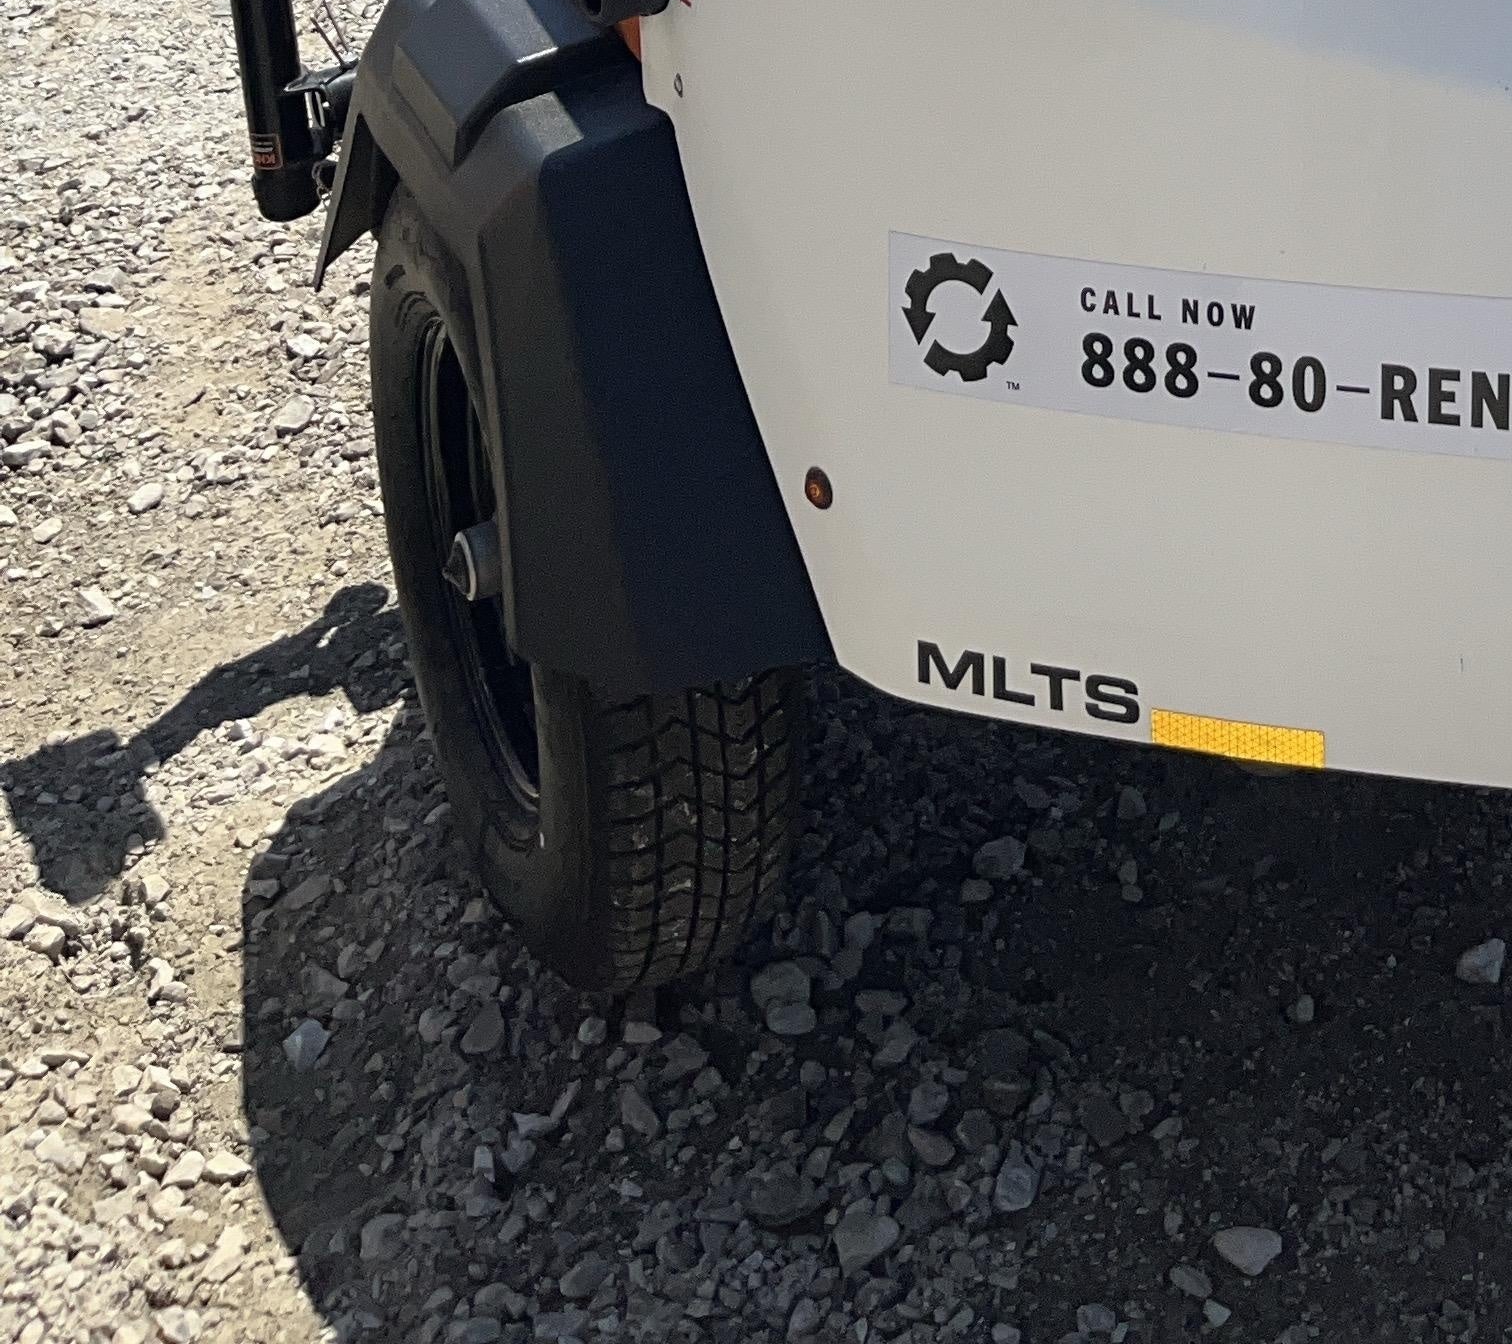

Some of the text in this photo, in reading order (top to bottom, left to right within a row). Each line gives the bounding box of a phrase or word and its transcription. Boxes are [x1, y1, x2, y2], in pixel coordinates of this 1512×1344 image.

[1079, 286, 1257, 331] CALL NOW
[915, 638, 1141, 725] MLTS
